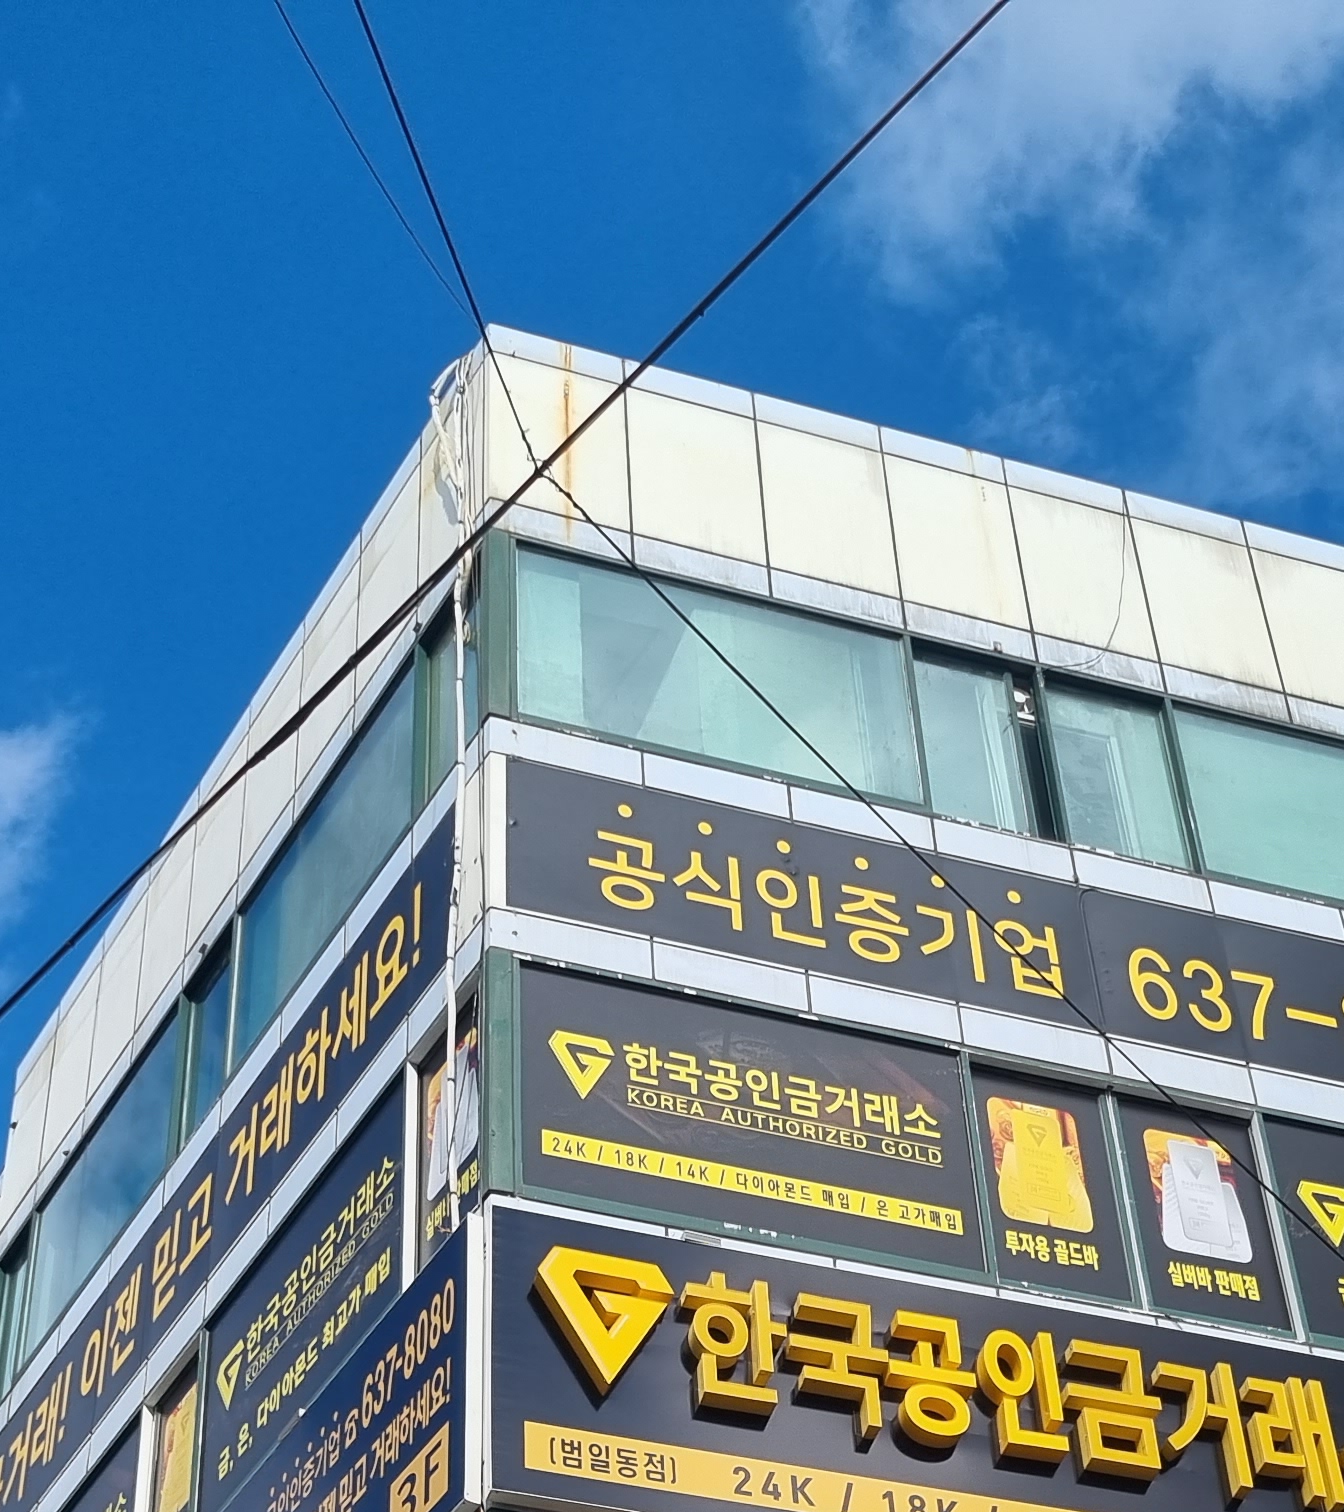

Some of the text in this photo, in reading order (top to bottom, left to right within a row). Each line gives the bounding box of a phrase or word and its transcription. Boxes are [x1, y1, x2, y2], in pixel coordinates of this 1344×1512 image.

[587, 827, 1065, 999] 공식인증기업
[622, 1042, 941, 1139] 한국공인금거래소
[627, 1086, 942, 1165] KOREA AUTHORIZED GOLD
[80, 1263, 144, 1397] 이젠
[150, 1188, 214, 1323] 믿고
[224, 881, 422, 1206] 거래하세요!
[552, 1136, 588, 1157] 24K
[614, 1148, 649, 1170] 18K
[676, 1160, 709, 1182] 14K
[735, 1171, 812, 1201] 다이아몬드
[821, 1189, 850, 1210] 매입
[875, 1199, 889, 1217] 은
[244, 1156, 395, 1362] 한국공인금거래소
[361, 1192, 395, 1239] GOLD
[1005, 1231, 1099, 1271] 투자용 골드바
[1167, 1261, 1260, 1302] 실버바 판매점
[256, 1343, 318, 1430] 다이아몬드
[322, 1290, 364, 1347] 최고가
[364, 1247, 392, 1297] 매입
[361, 1277, 454, 1429] 637-8080
[731, 1466, 817, 1508] 24K
